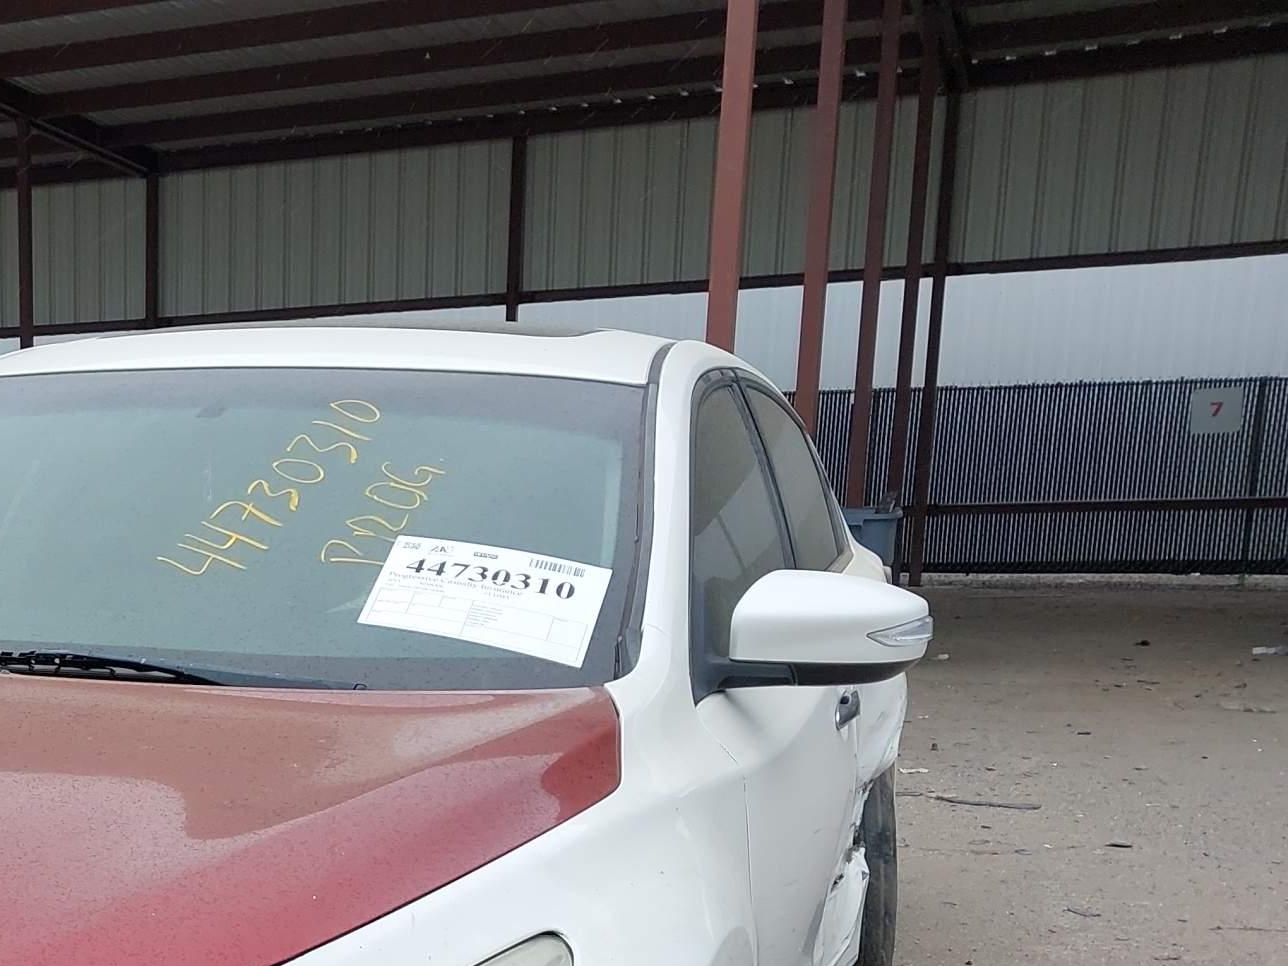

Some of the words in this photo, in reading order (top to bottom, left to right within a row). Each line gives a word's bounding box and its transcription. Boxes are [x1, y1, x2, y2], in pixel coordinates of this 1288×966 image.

[1209, 401, 1224, 417] 7
[156, 399, 381, 576] 44730310
[406, 557, 576, 600] 44730310
